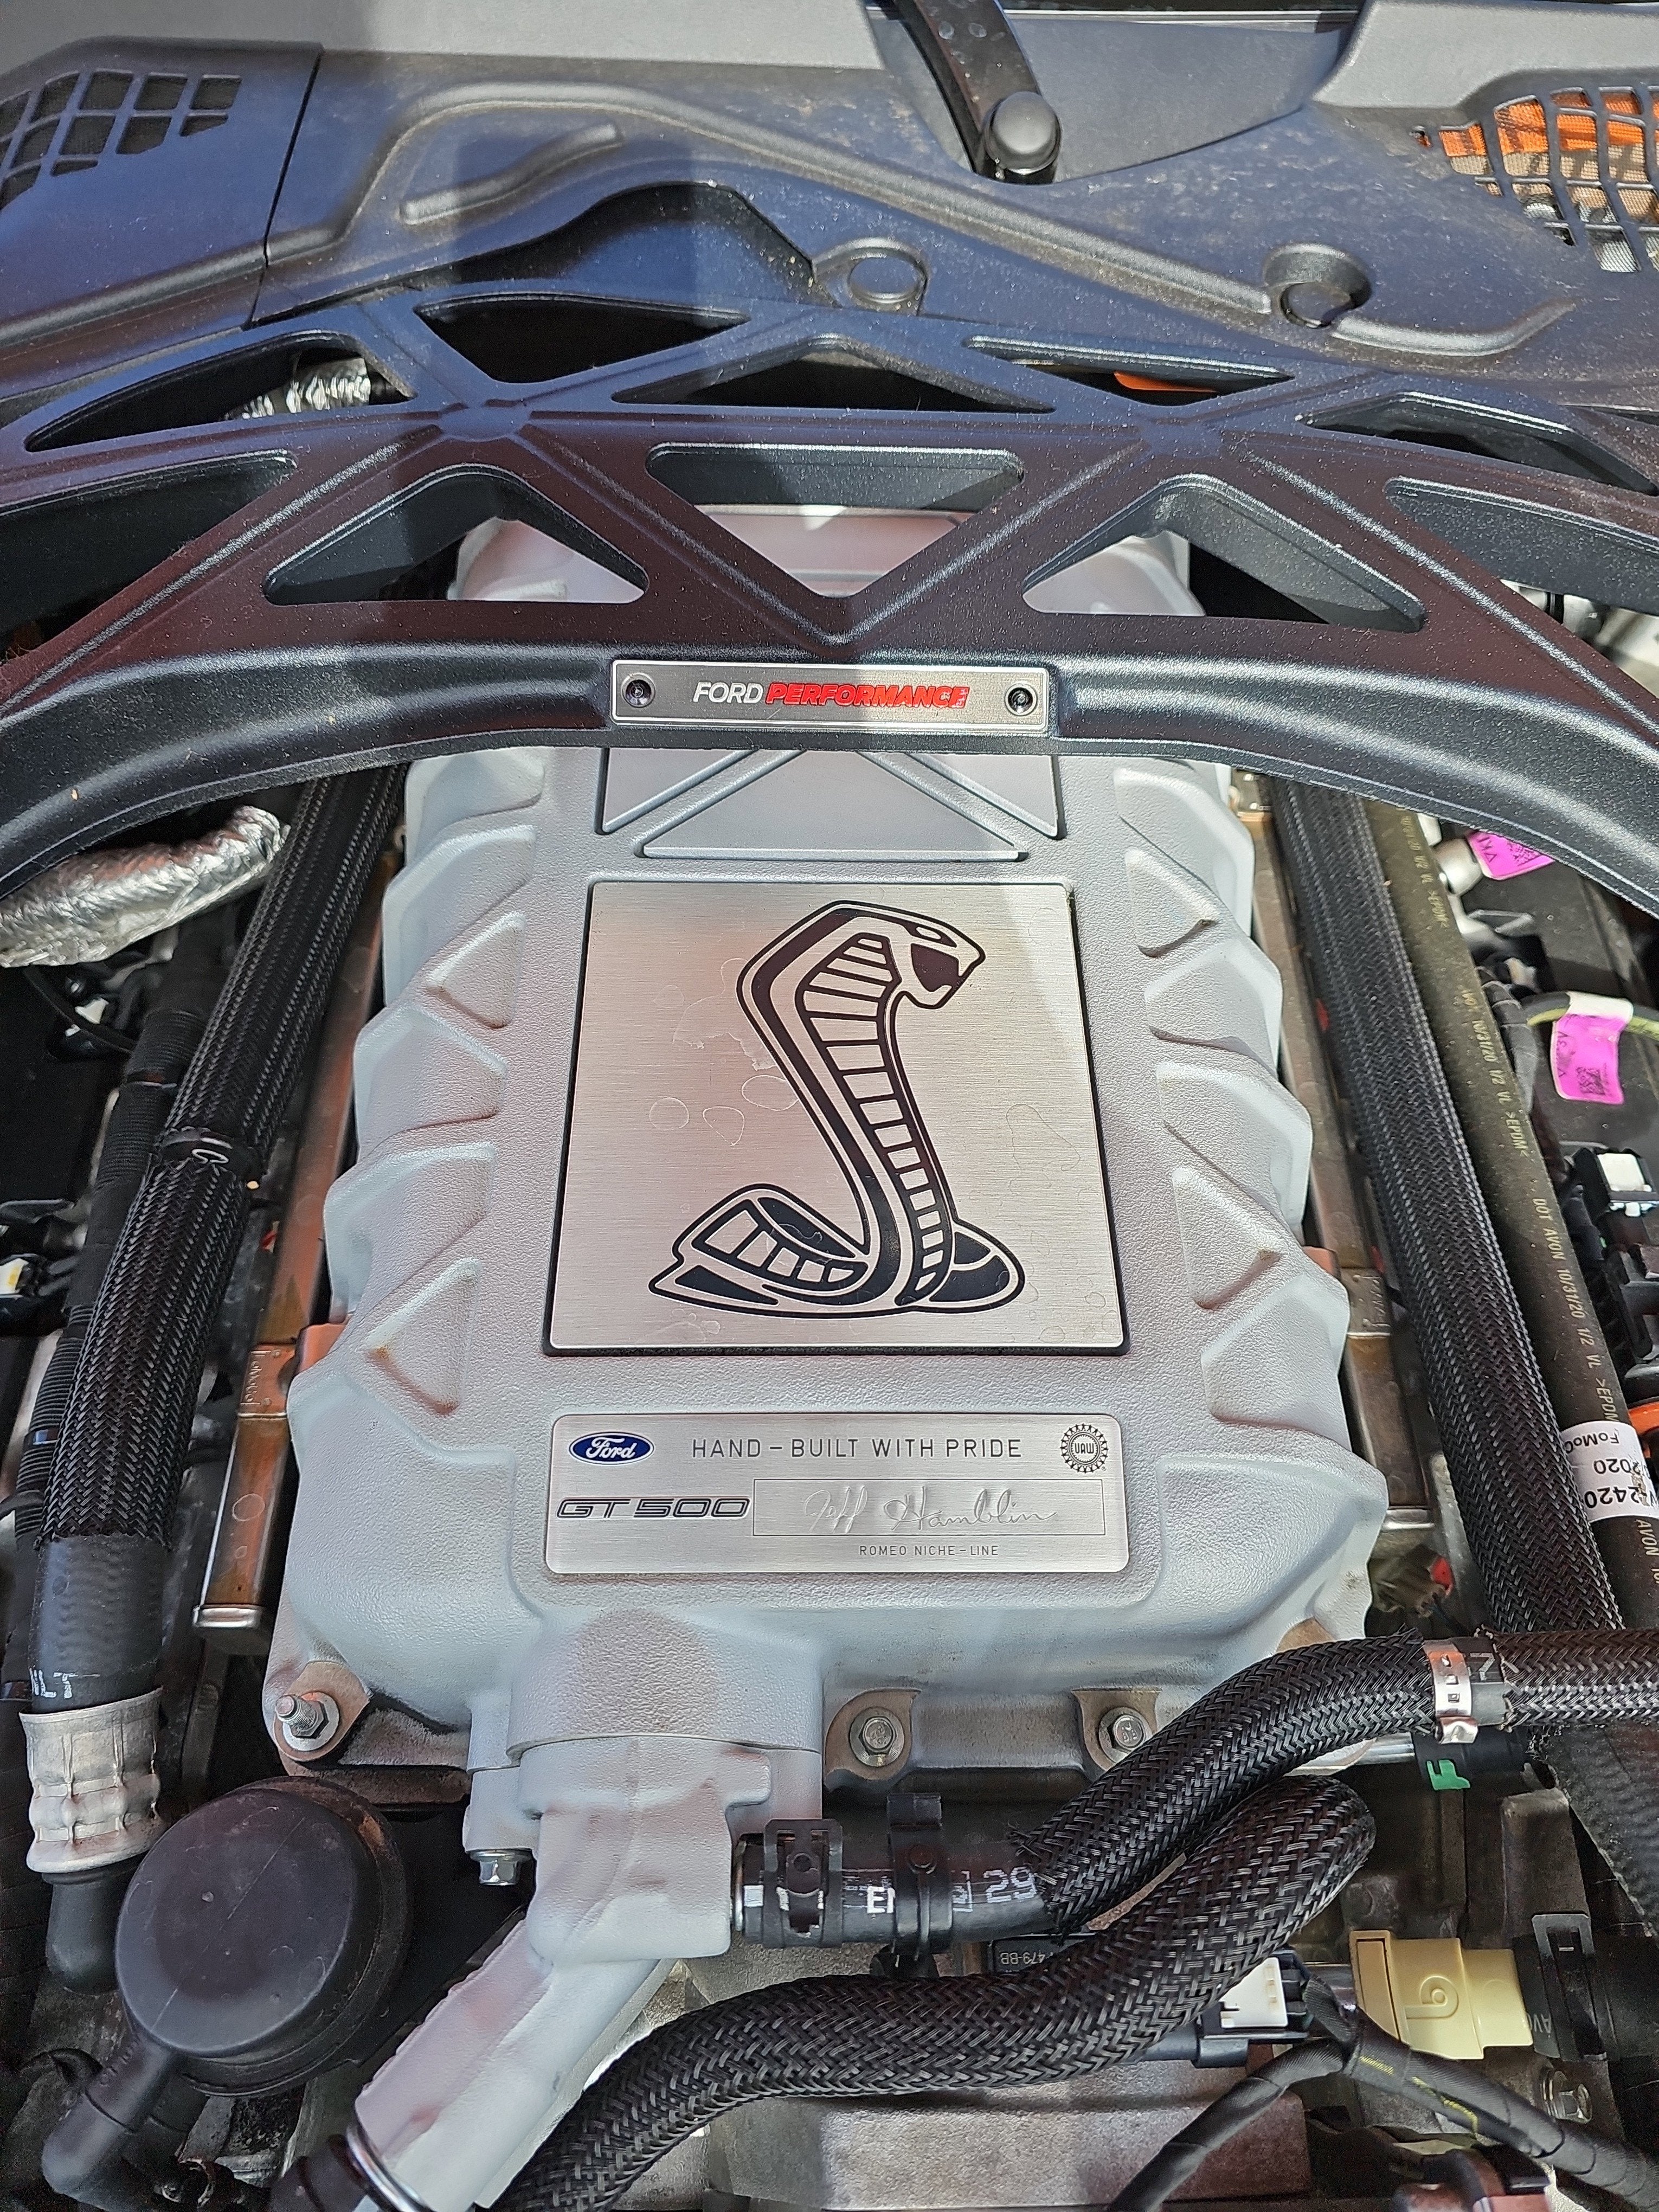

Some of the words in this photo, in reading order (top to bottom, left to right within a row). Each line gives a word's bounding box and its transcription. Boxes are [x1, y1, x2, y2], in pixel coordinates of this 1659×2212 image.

[693, 681, 764, 704] FORD
[765, 683, 970, 708] PERFORMANCE
[1496, 1091, 1512, 1104] VL
[1543, 1227, 1566, 1261] AVON
[1557, 1268, 1587, 1319] 10/31/20
[1577, 1326, 1596, 1346] 1/2
[1585, 1353, 1602, 1369] VL
[586, 1437, 636, 1458] Ford
[871, 1439, 934, 1457] WITH
[947, 1439, 1021, 1457] PRIDE
[1075, 1443, 1095, 1454] UAW
[884, 1486, 1056, 1532] Hamblin
[859, 1545, 907, 1555] ROMEO
